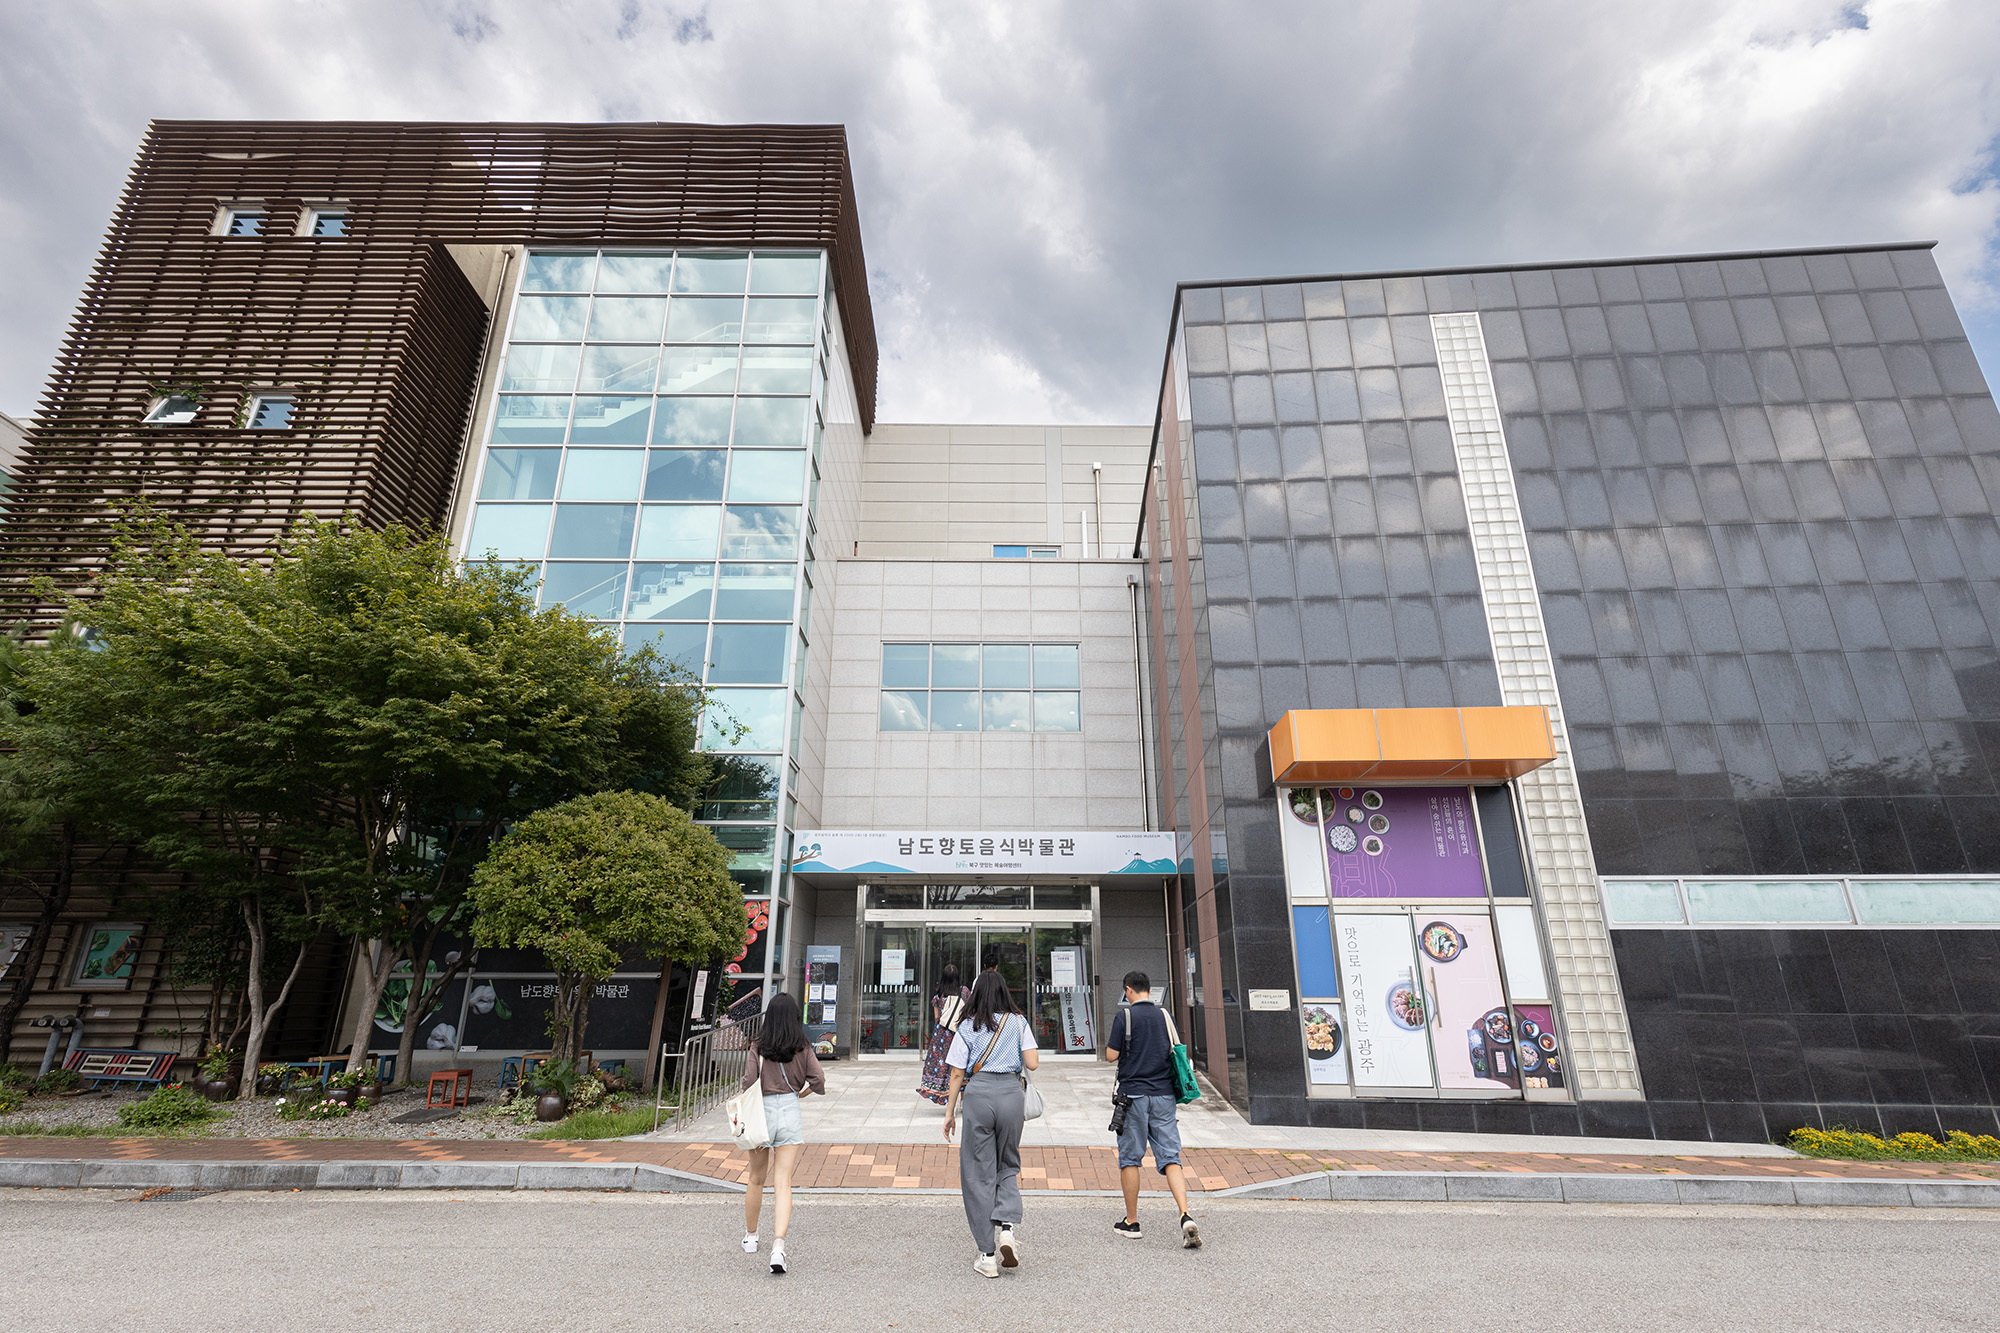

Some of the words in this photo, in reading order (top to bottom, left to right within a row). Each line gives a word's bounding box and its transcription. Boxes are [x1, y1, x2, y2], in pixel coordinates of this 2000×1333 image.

[1453, 797, 1463, 817] 남도의
[897, 836, 1076, 858] 남도향토음식박물관
[1344, 926, 1361, 967] 맛으로
[1351, 972, 1369, 1033] 기억하는
[1357, 1038, 1375, 1074] 광주
